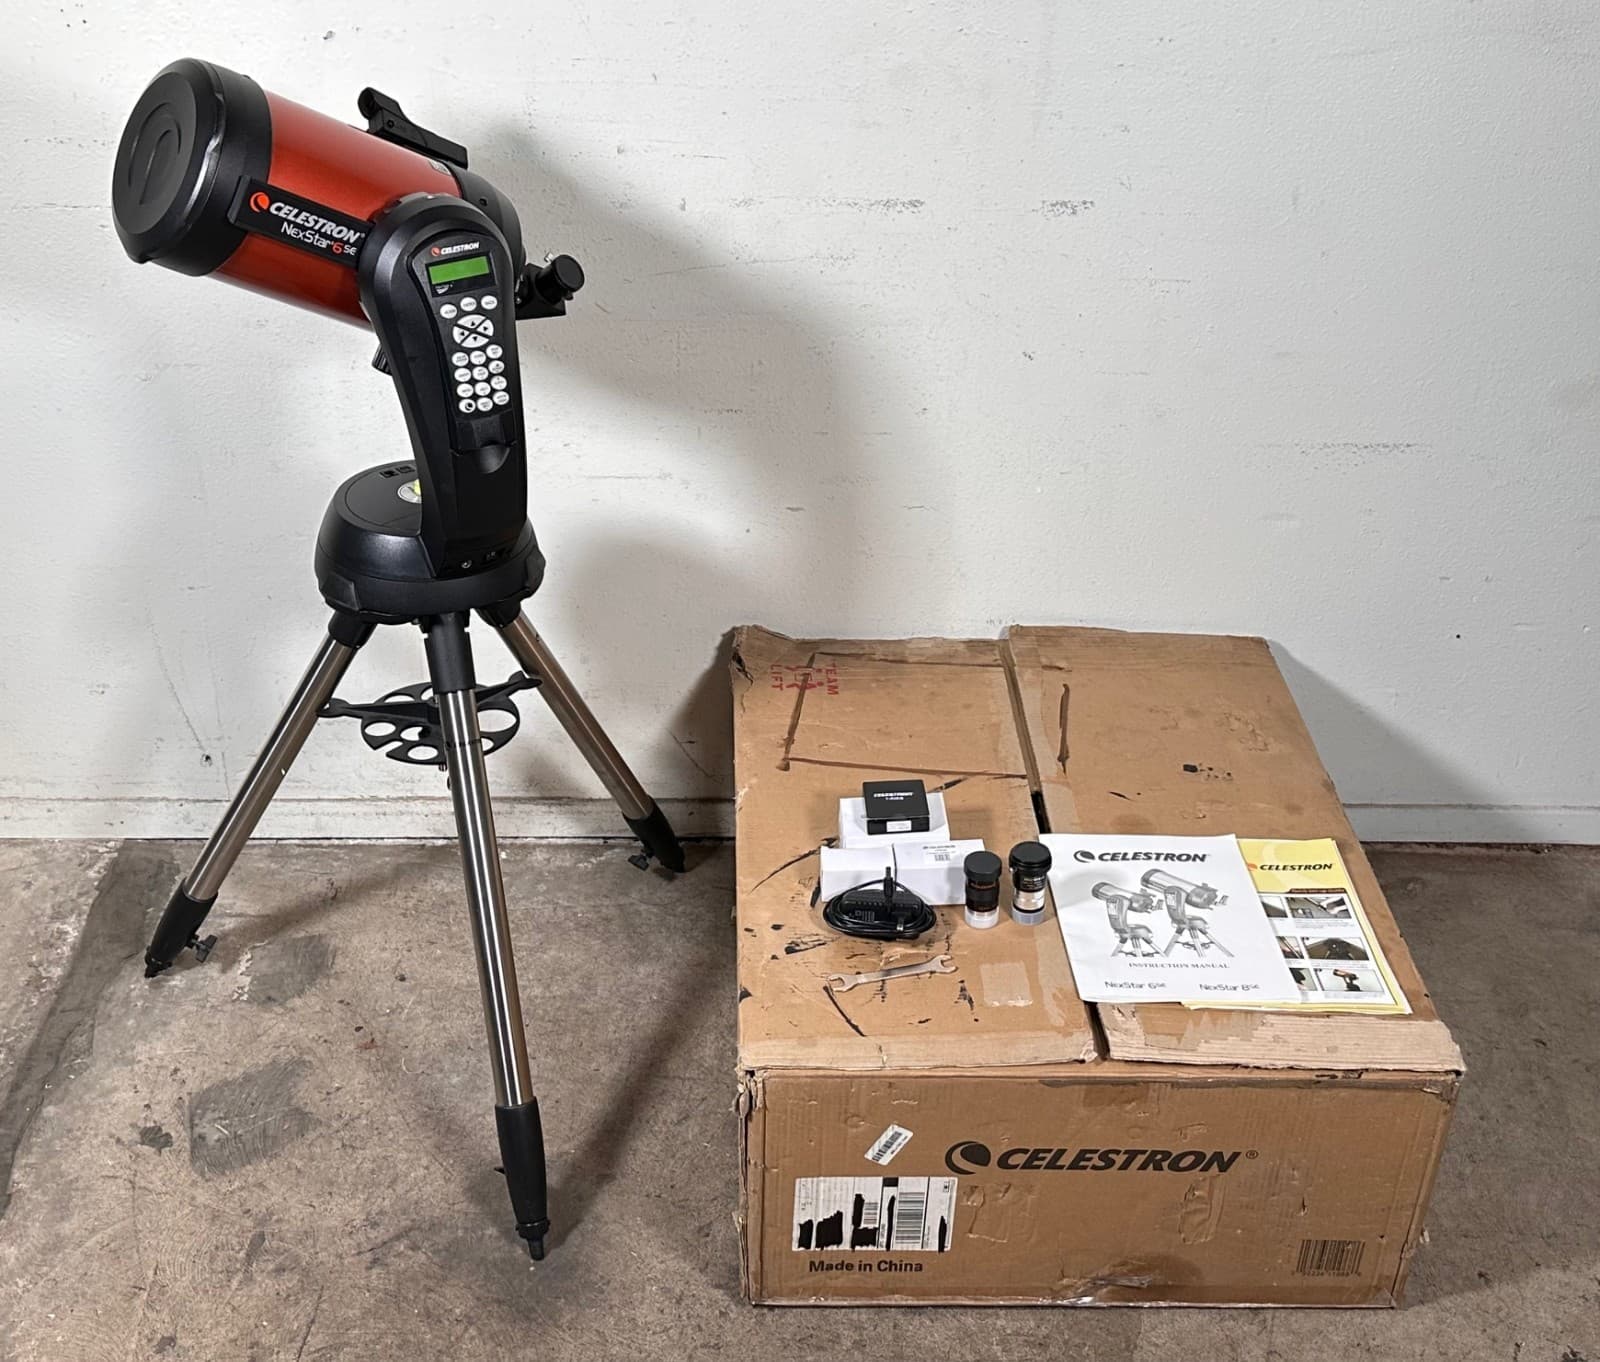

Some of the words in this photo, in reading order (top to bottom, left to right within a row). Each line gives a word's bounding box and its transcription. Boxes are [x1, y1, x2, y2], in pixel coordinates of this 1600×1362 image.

[441, 242, 480, 255] CELESTRON
[771, 664, 783, 691] LIFT
[825, 662, 839, 695] TEAM
[1098, 852, 1208, 862] CELESTRON
[1260, 863, 1333, 871] CELESTRON
[809, 1260, 854, 1272] Made
[858, 1260, 873, 1272] in
[877, 1260, 924, 1272] China
